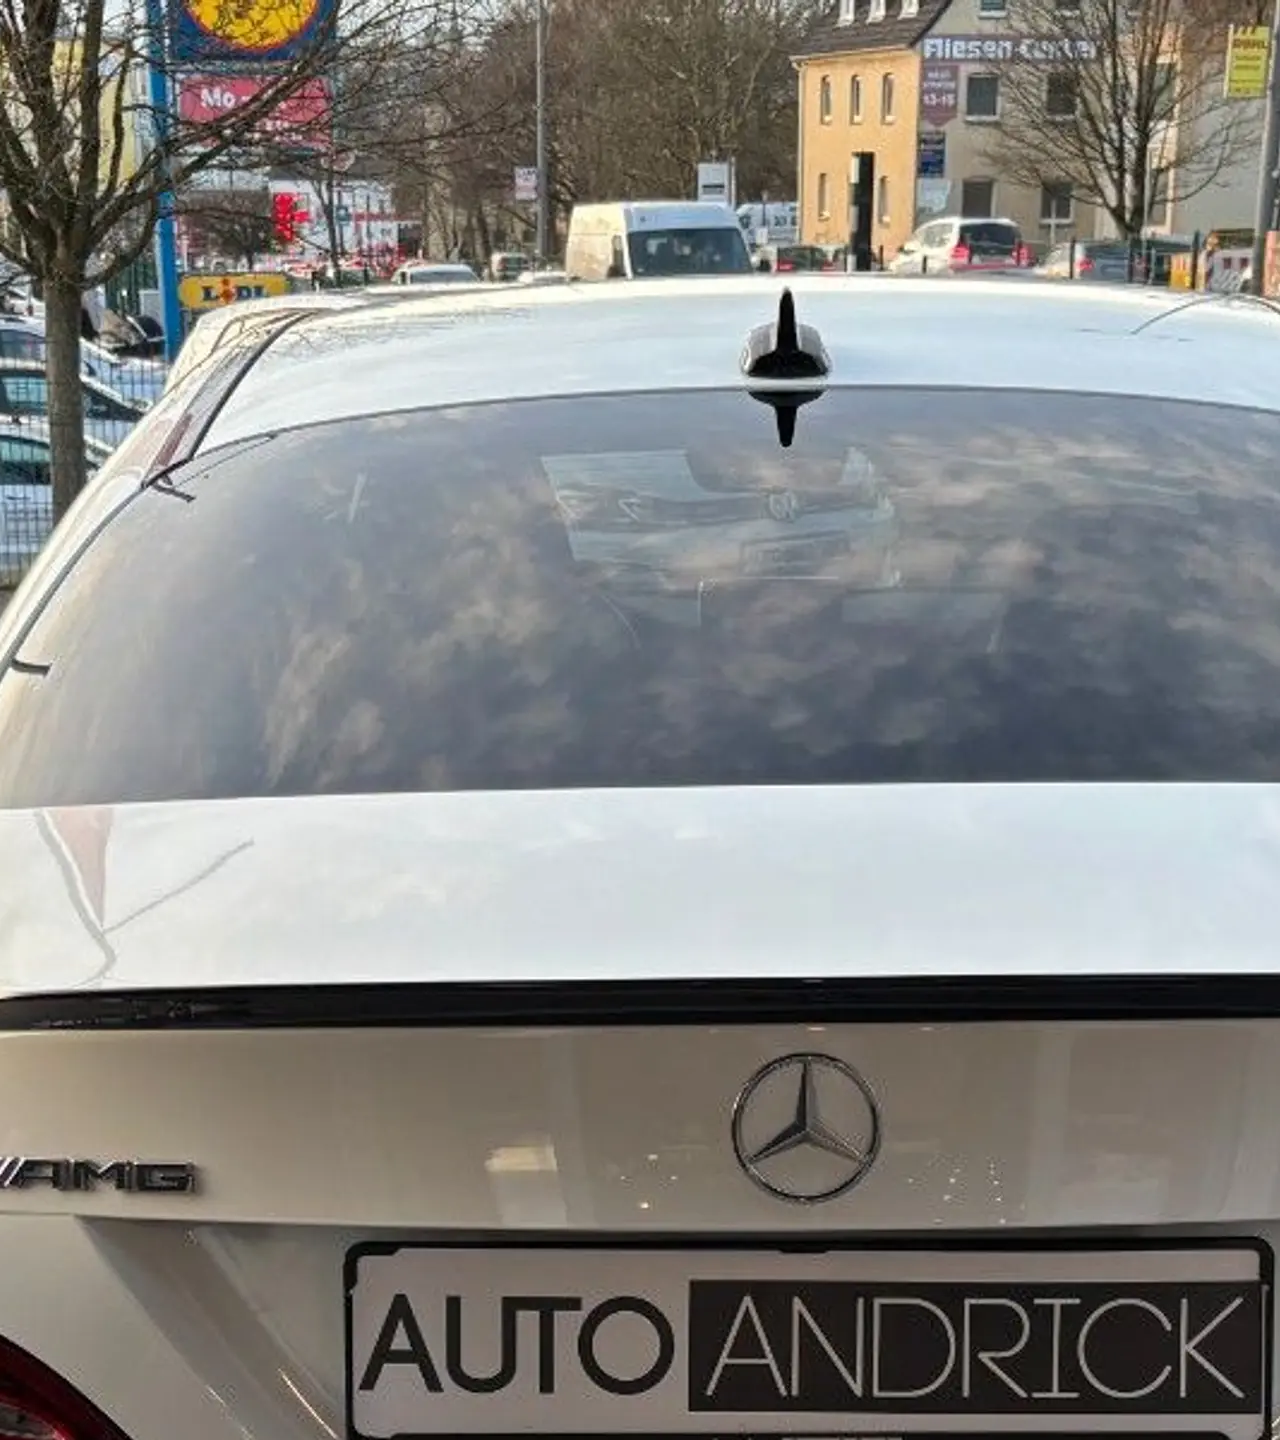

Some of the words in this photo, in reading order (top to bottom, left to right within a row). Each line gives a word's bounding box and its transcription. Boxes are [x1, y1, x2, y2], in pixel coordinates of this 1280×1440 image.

[18, 1157, 198, 1191] AMG
[358, 1293, 675, 1395] AUTO
[705, 1294, 1246, 1399] ANDRICK
